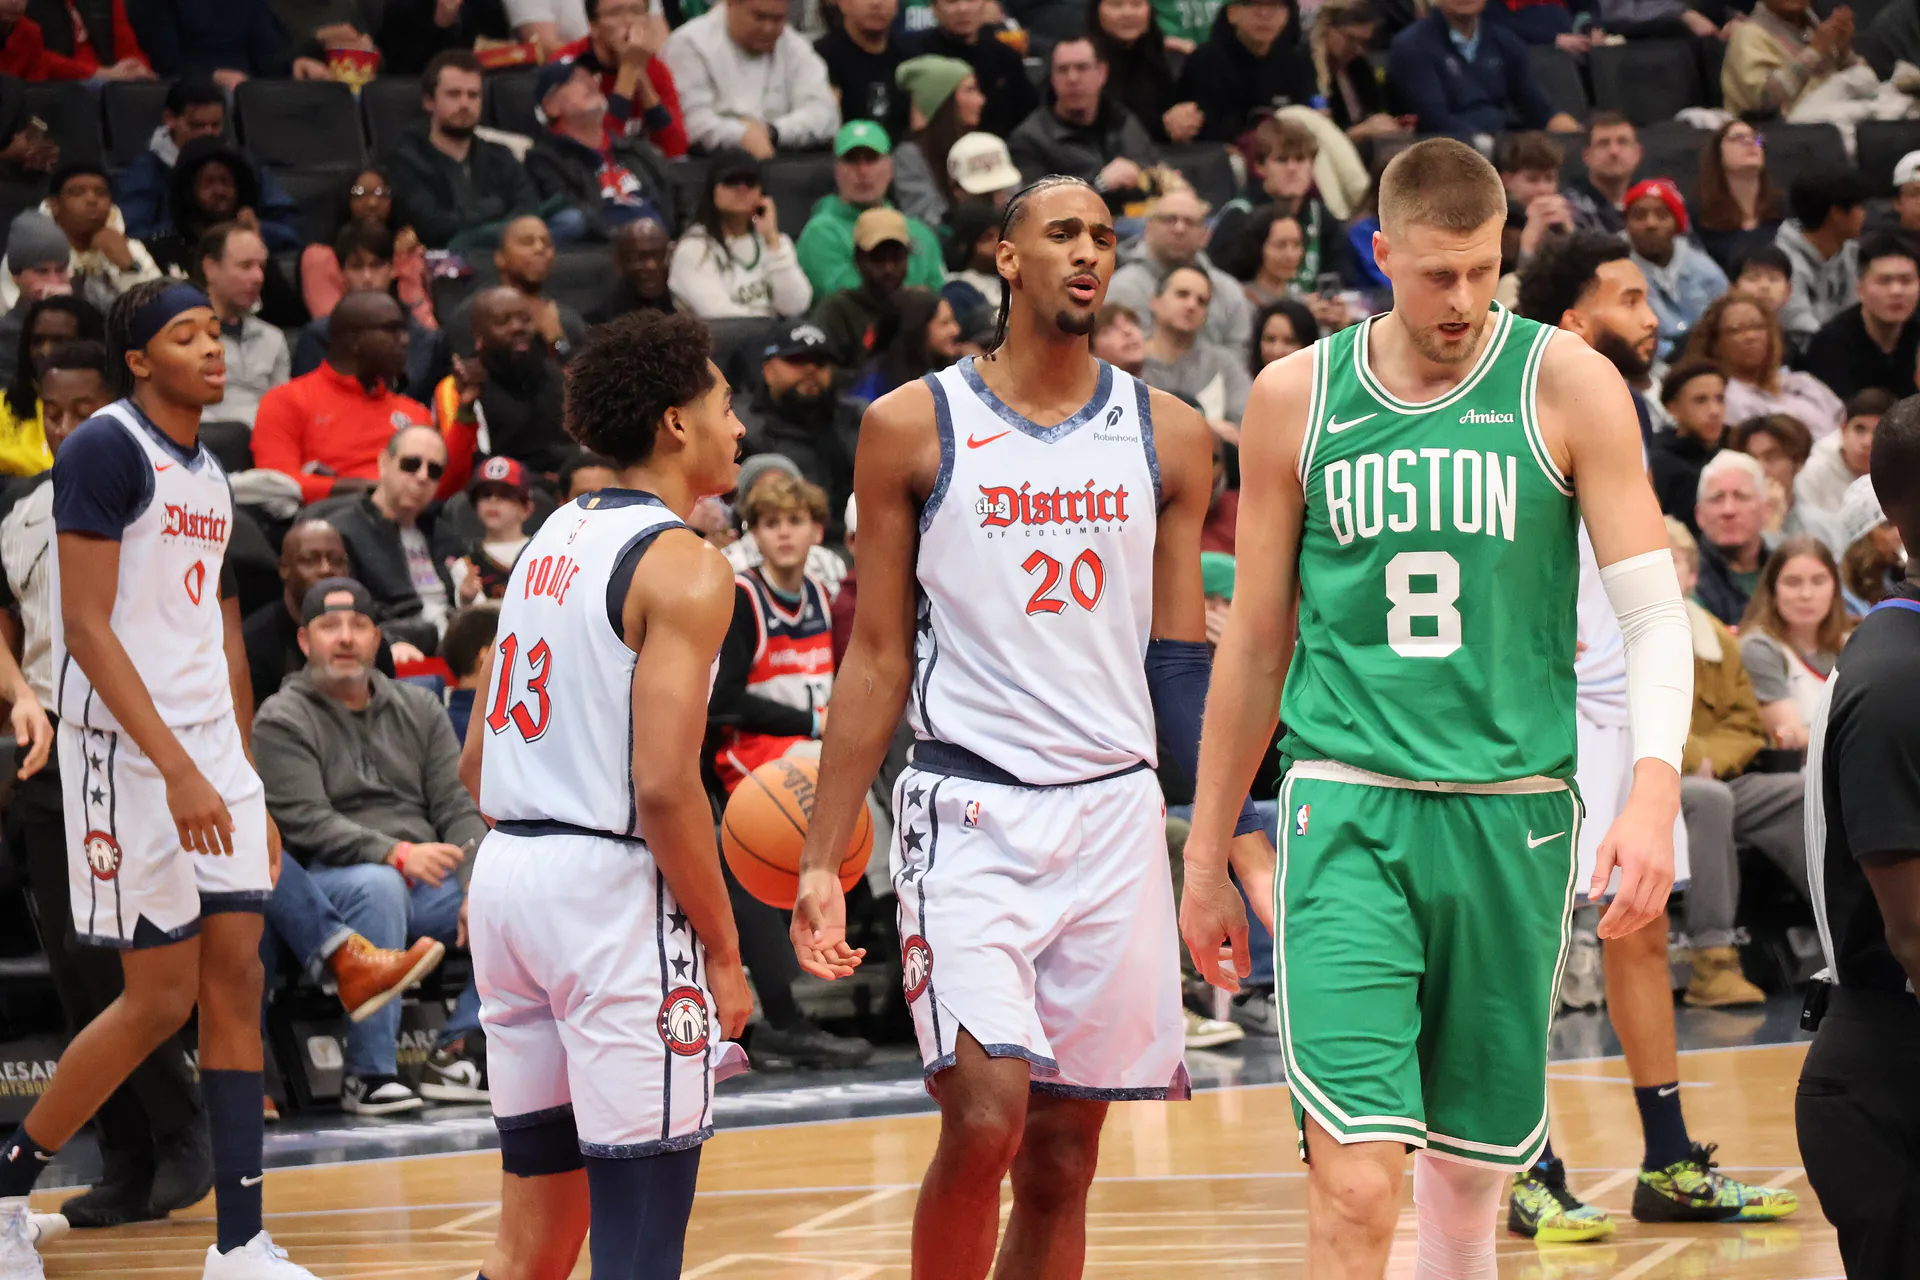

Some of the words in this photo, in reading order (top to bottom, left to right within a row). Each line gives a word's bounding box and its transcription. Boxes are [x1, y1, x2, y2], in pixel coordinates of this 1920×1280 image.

[1093, 432, 1138, 444] Robinhood
[1459, 408, 1514, 424] Amica
[975, 497, 1005, 515] the
[978, 478, 1129, 528] District
[1324, 448, 1517, 546] BOSTON
[161, 501, 227, 543] District
[987, 531, 1006, 539] OF
[1025, 525, 1123, 537] COLUMBIA
[184, 559, 206, 607] 0
[524, 555, 580, 607] POOLE
[1021, 548, 1107, 617] 20
[1385, 551, 1462, 658] 8
[486, 632, 553, 744] 13
